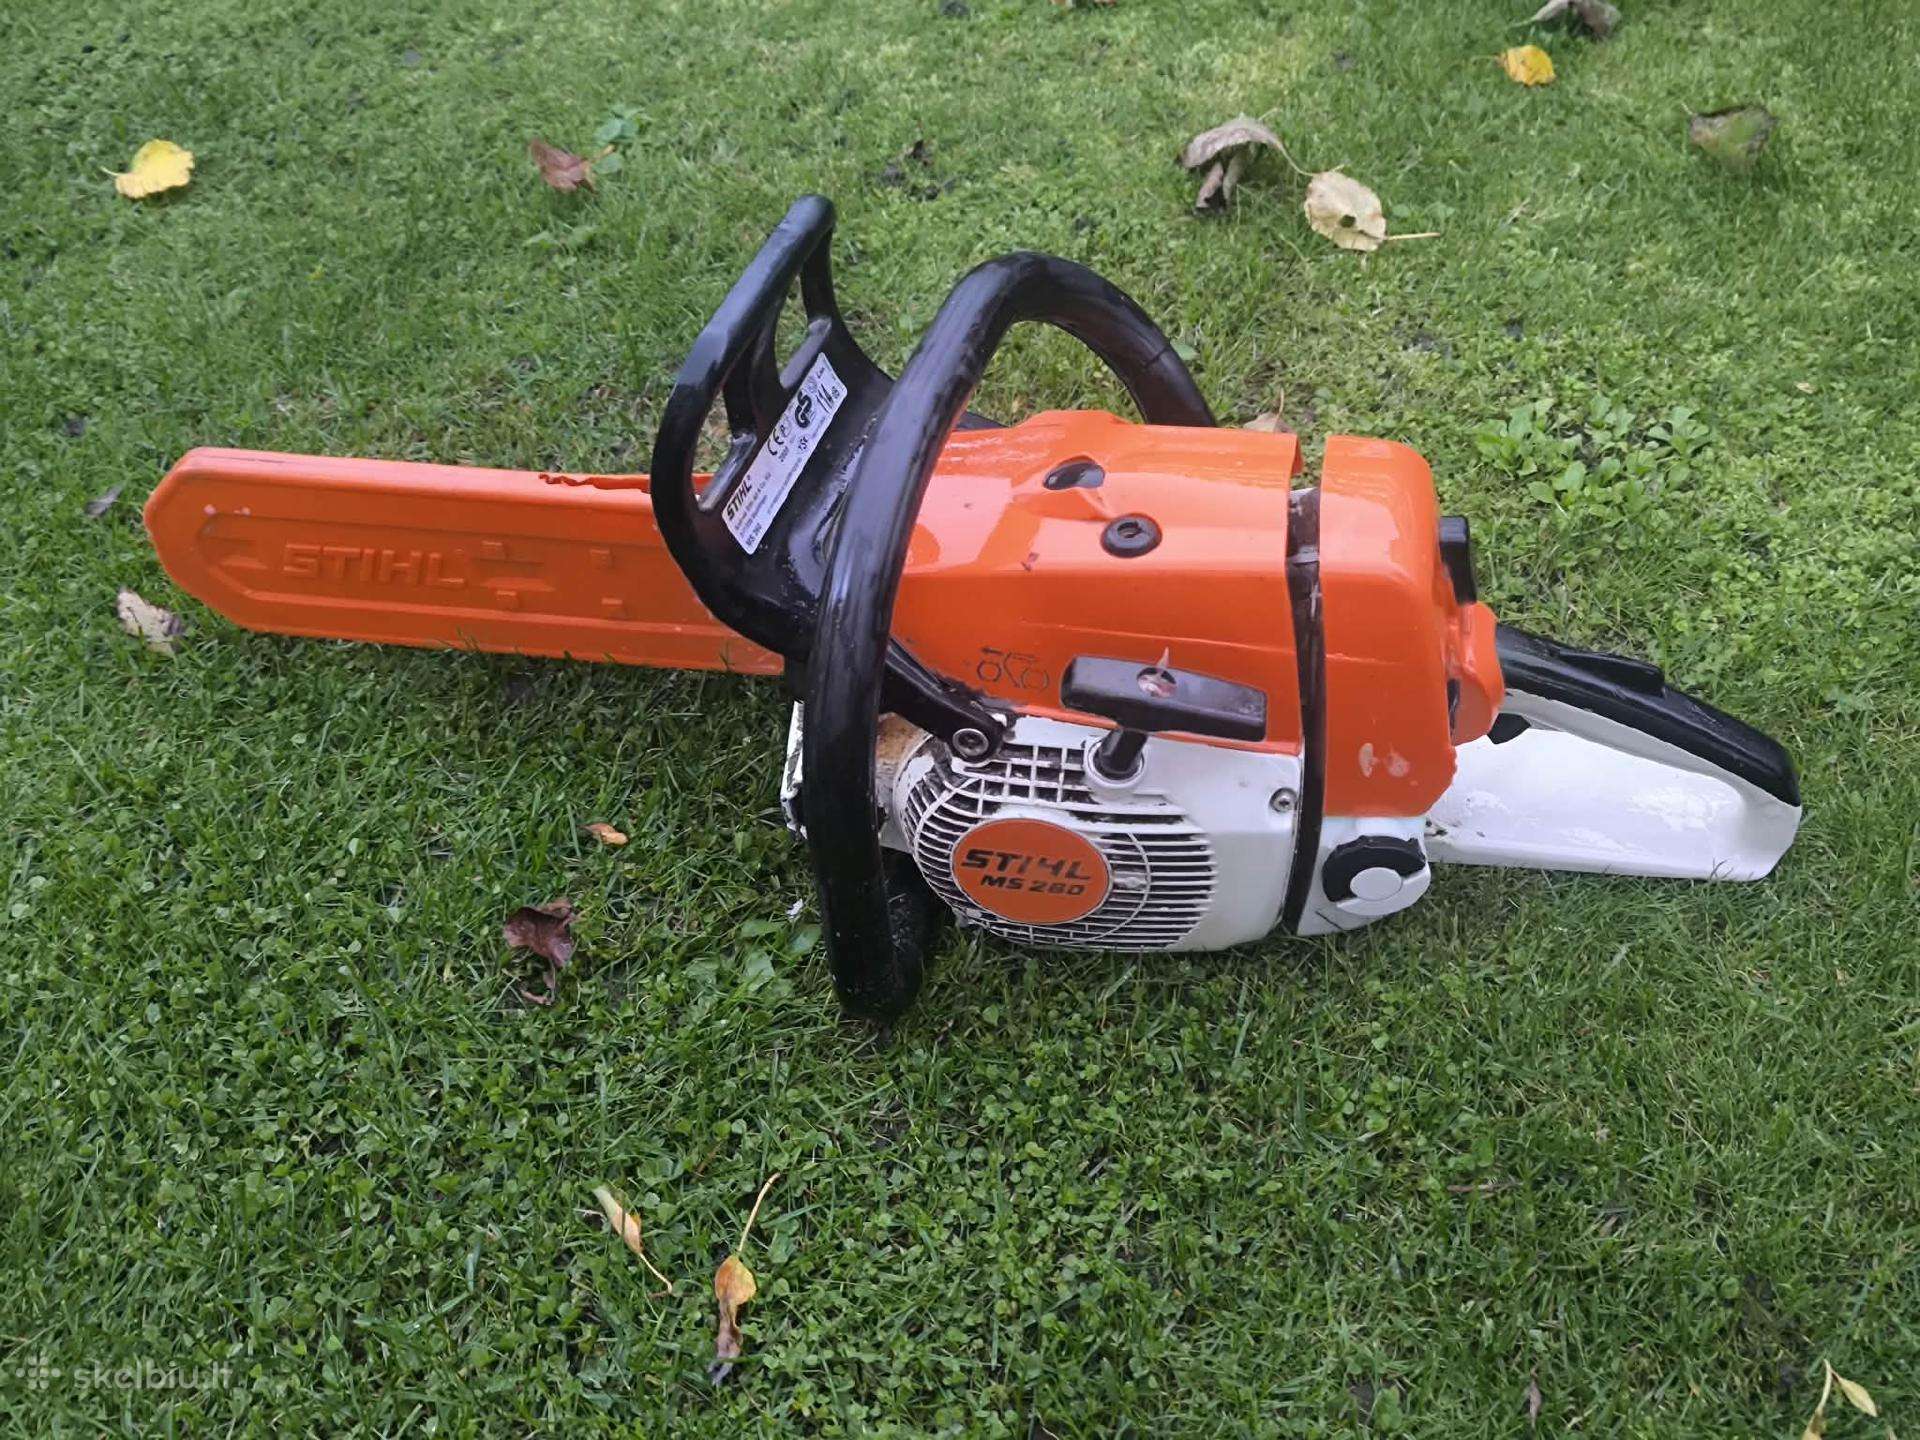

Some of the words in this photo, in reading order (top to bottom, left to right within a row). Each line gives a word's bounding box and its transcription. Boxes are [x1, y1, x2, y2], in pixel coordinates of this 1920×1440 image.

[725, 477, 752, 522] STIHL
[283, 543, 466, 587] STIHL
[961, 848, 1091, 880] STIHL
[980, 875, 1025, 890] MS
